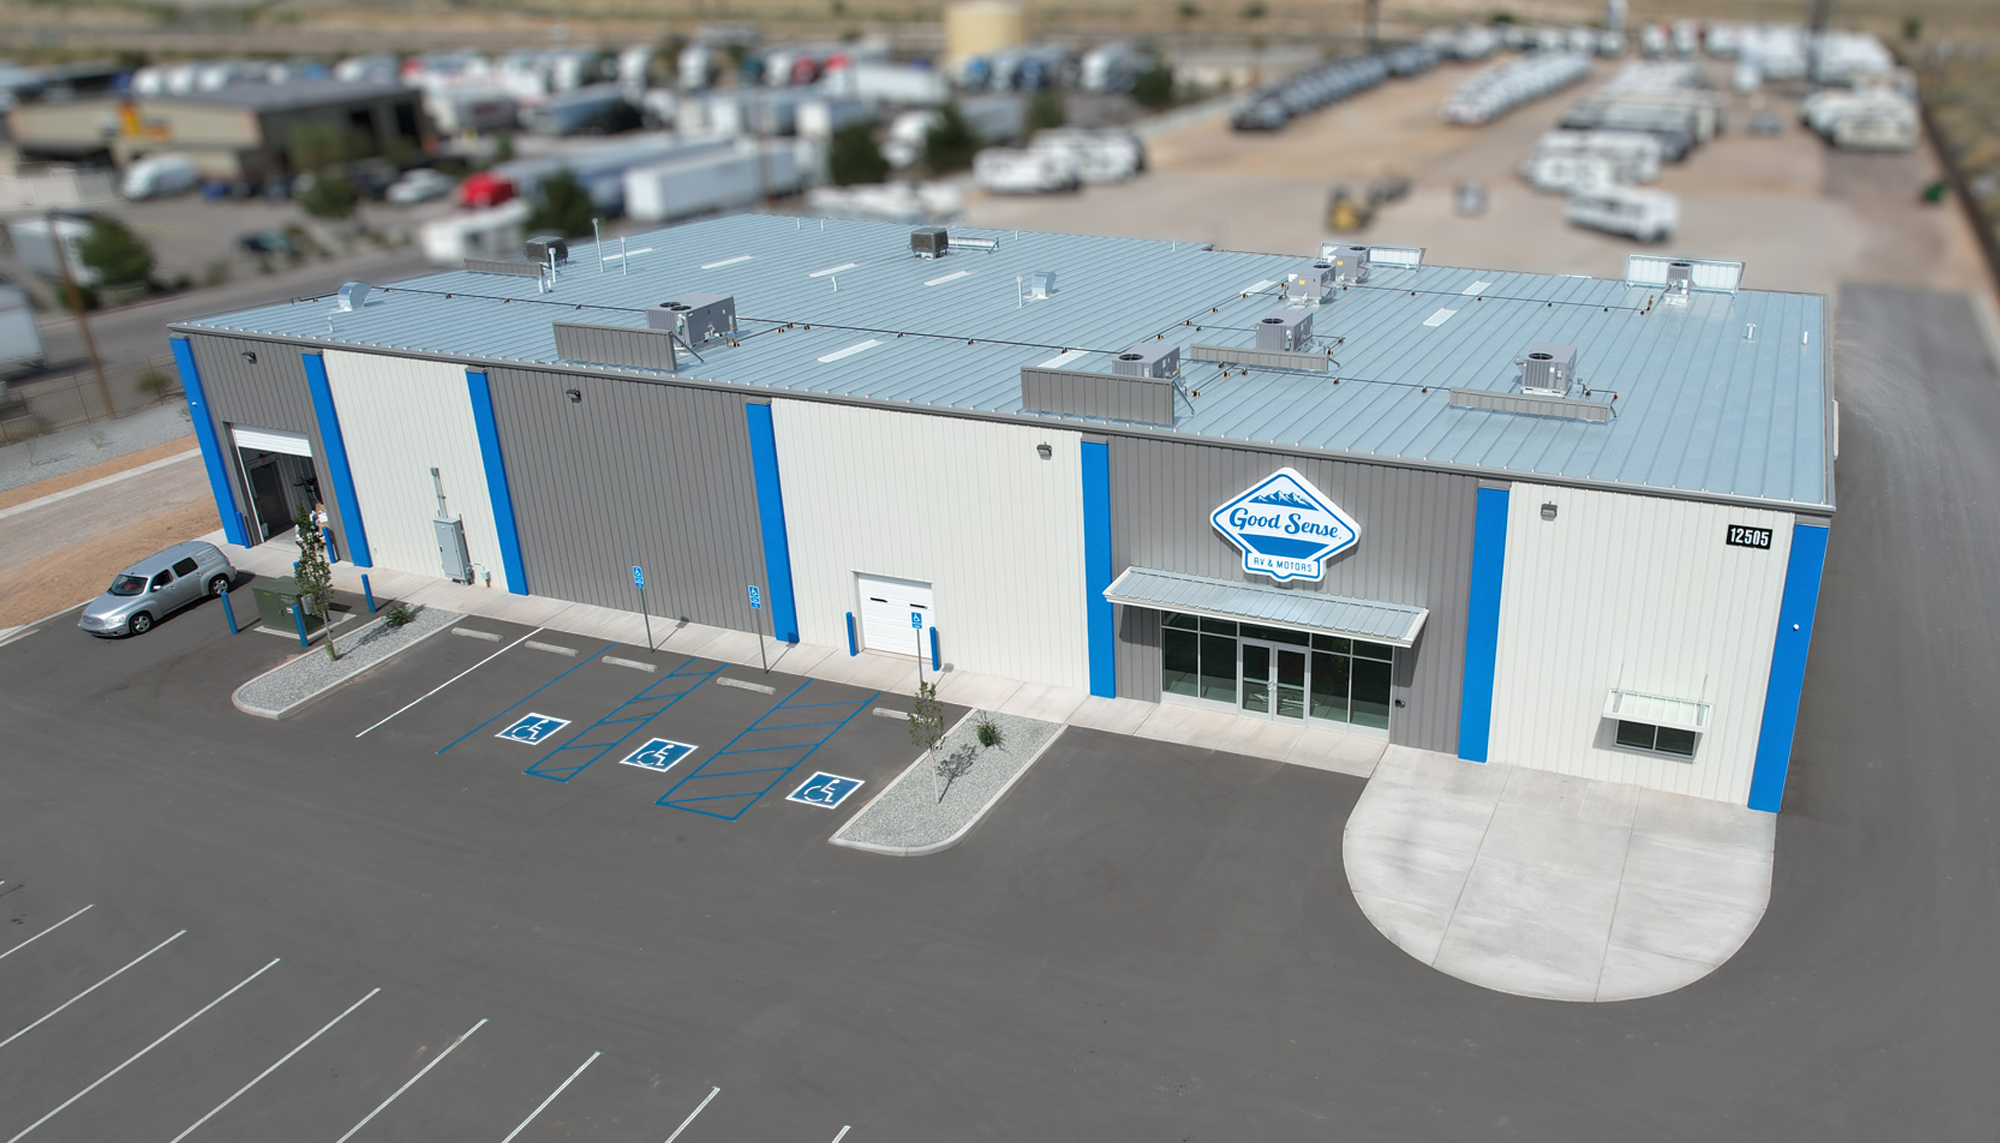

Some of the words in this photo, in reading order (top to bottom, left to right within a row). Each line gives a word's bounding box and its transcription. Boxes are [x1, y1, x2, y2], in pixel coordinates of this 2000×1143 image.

[1229, 507, 1281, 531] Good
[1730, 527, 1770, 547] 12505
[1253, 557, 1265, 567] RV
[1267, 559, 1274, 568] &
[1276, 560, 1313, 573] MOTORS
